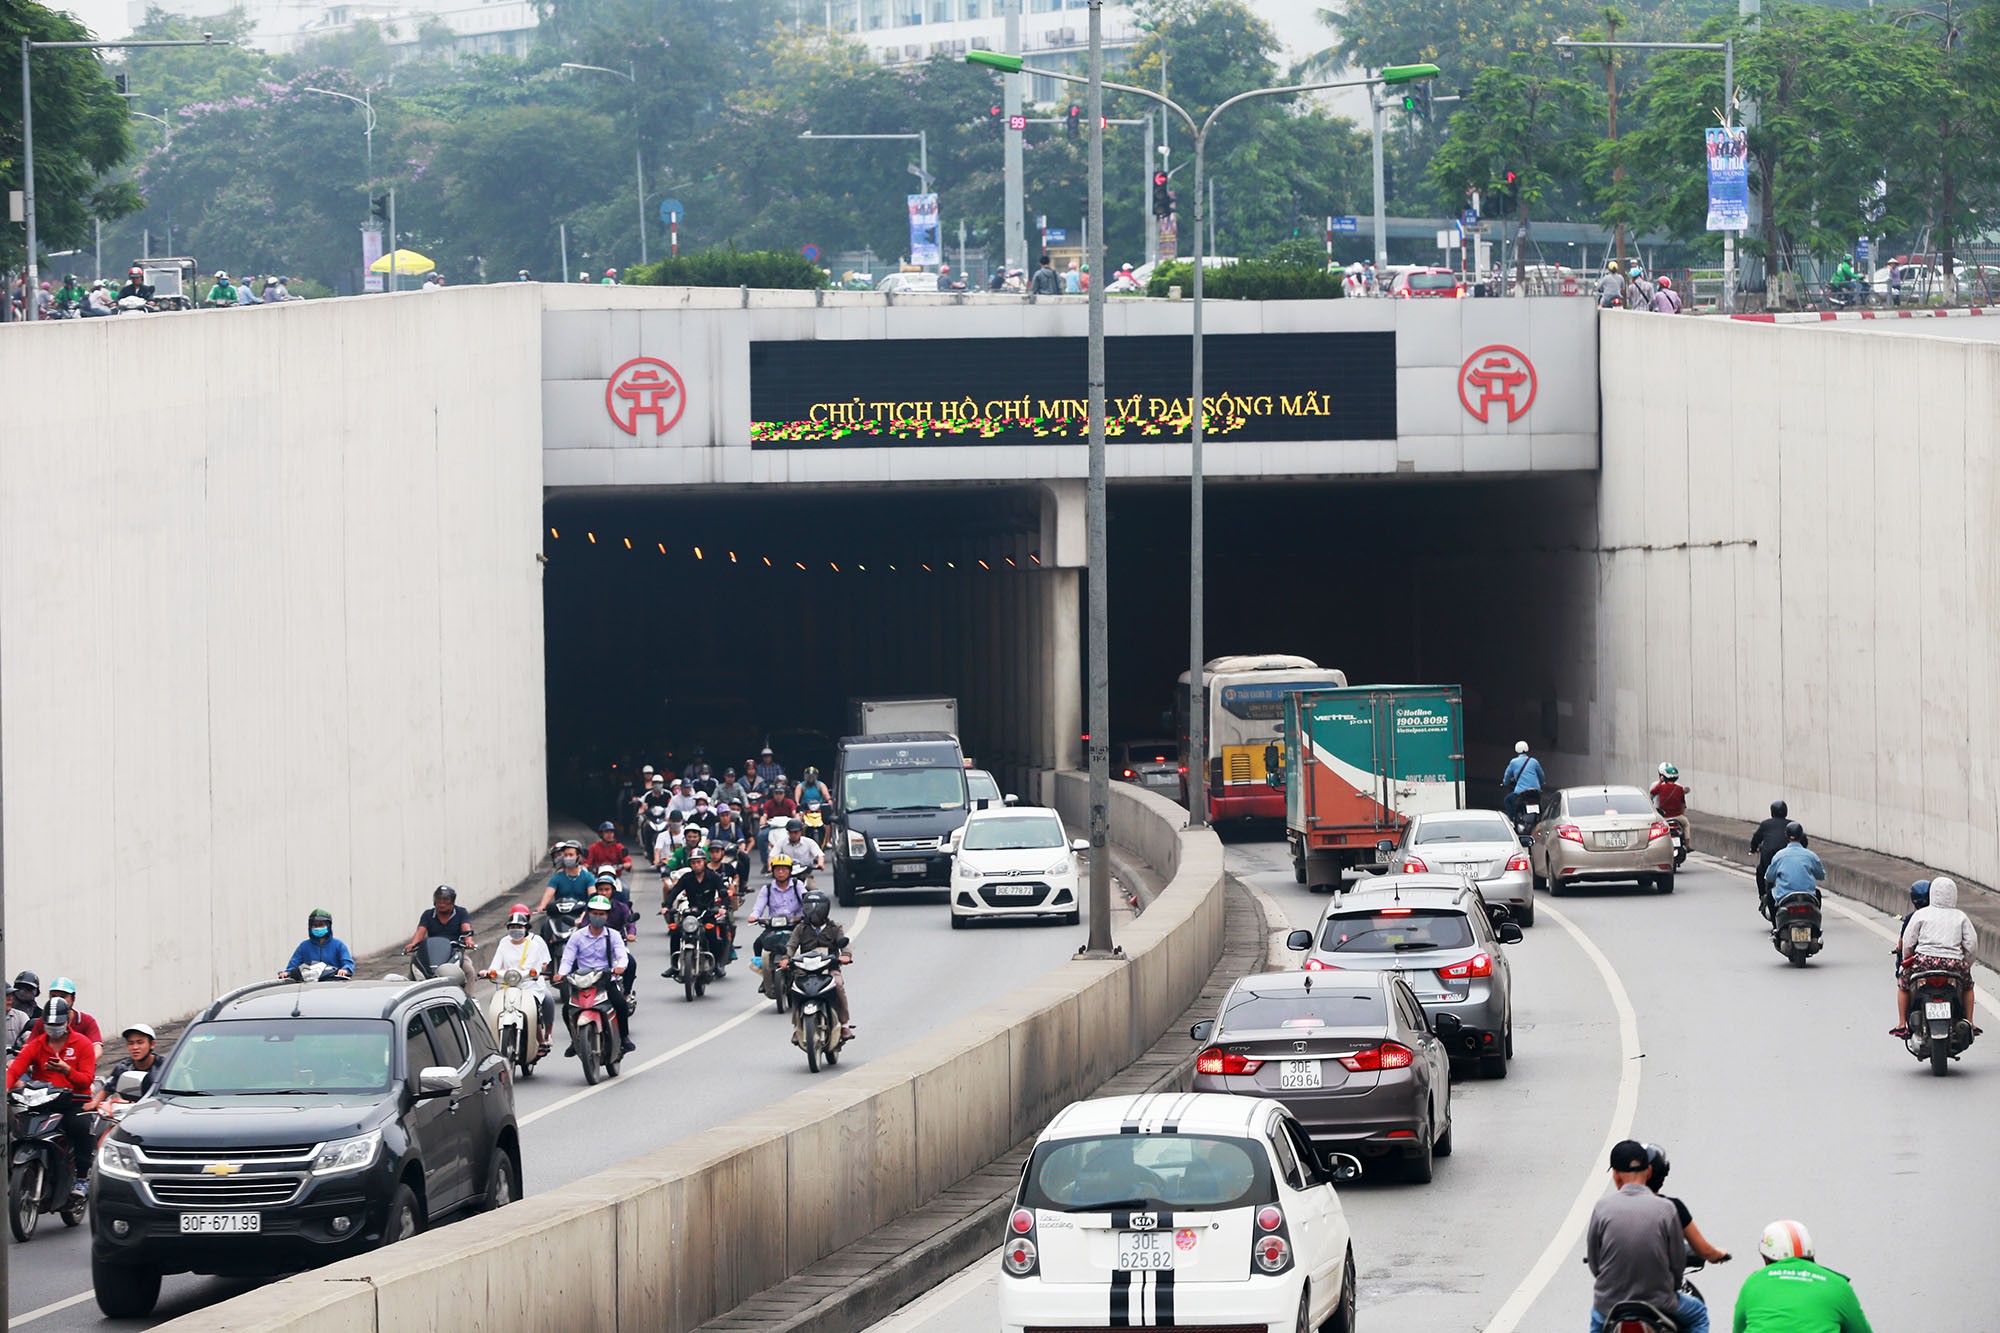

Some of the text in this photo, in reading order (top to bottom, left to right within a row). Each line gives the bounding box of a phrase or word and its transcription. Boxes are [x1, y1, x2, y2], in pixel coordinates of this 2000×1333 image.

[1011, 116, 1024, 129] 99
[985, 394, 1031, 420] CHÍ
[1037, 399, 1107, 419] MIN
[1280, 391, 1331, 416] MÃI
[1397, 716, 1448, 726] 1900.8095
[1290, 1061, 1311, 1073] 30E
[1282, 1074, 1320, 1087] 029.64
[182, 1215, 258, 1231] 30F-671.99
[1135, 1218, 1152, 1226] KIA
[1132, 1234, 1159, 1250] 30E
[1121, 1252, 1171, 1268] 625.82
